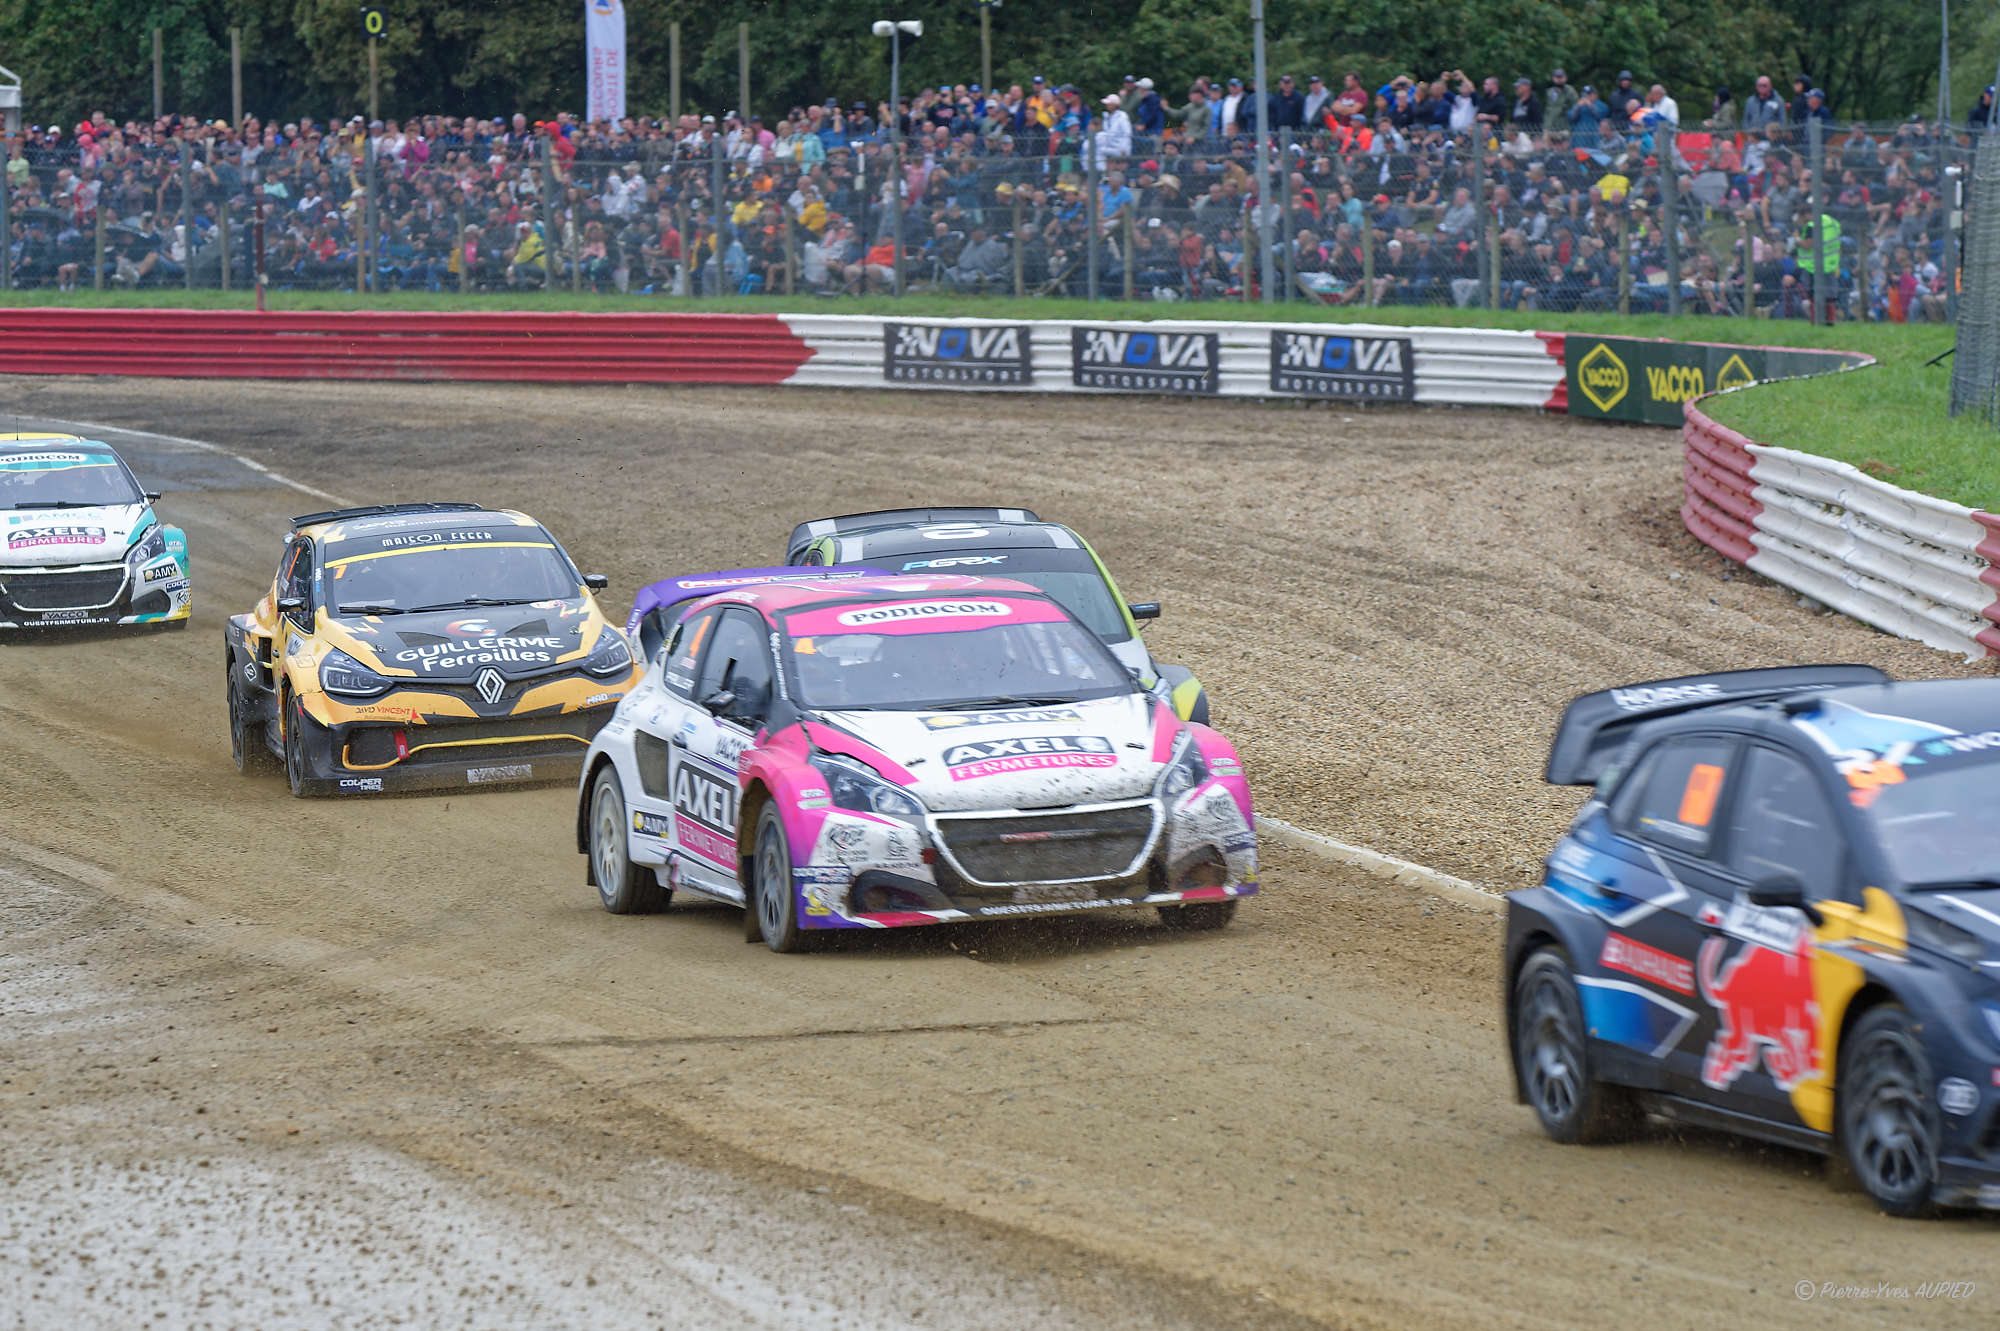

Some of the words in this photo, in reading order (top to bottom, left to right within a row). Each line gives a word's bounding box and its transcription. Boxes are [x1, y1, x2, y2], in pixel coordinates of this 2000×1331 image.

[365, 11, 383, 33] 0
[1081, 373, 1208, 391] MOTORSPORT
[1279, 377, 1404, 396] MOTORSPORT
[1586, 367, 1621, 388] YACCO
[1646, 365, 1704, 402] YACCO
[13, 536, 105, 549] FERMETURES
[155, 565, 175, 578] AMY
[851, 603, 999, 622] PODIOCOM
[396, 637, 565, 662] GUILLERME
[422, 649, 551, 672] Ferrailles
[955, 754, 1113, 779] FERMETURES
